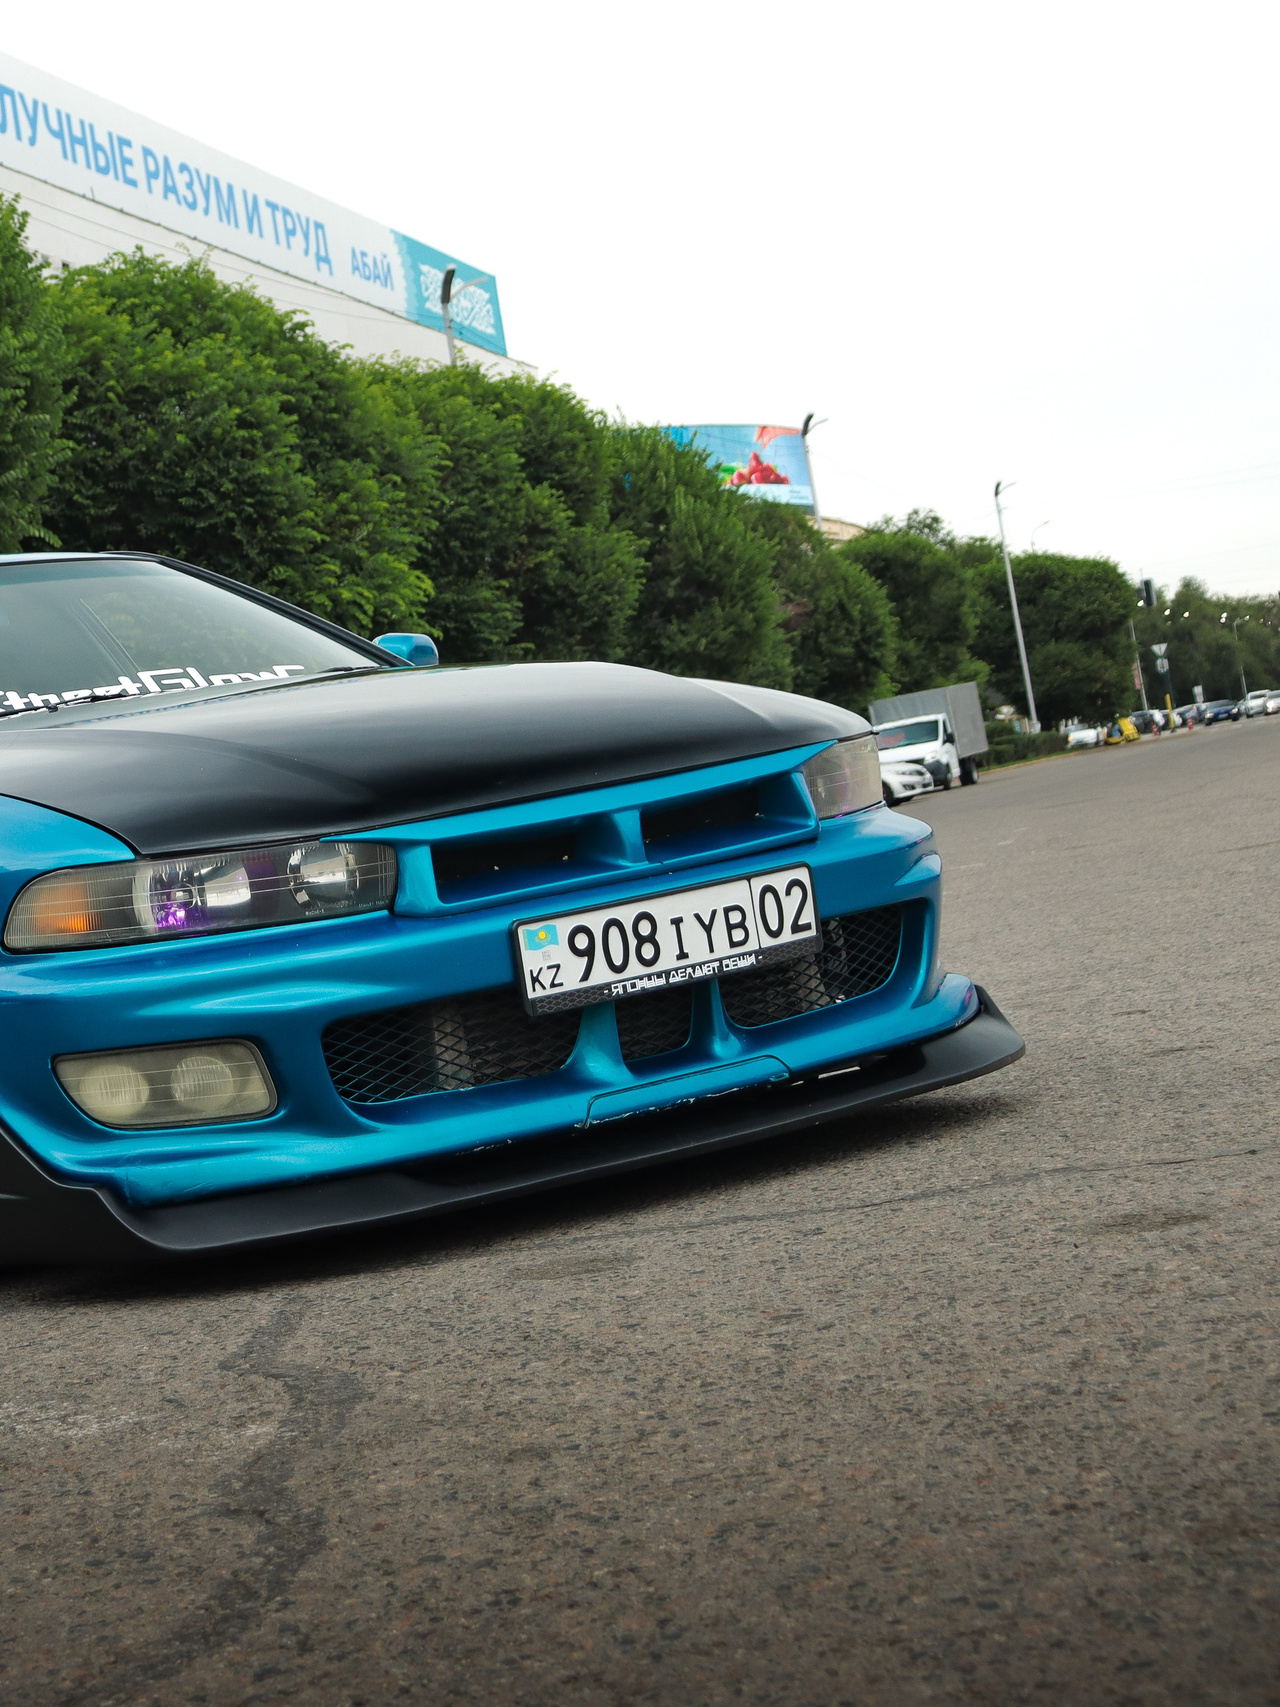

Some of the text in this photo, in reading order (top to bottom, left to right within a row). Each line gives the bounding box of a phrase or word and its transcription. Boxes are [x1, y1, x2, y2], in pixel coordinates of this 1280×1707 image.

[141, 143, 240, 230] РАЗУМ
[242, 188, 264, 240] И
[264, 198, 334, 277] ТРУД
[350, 246, 395, 292] АБАЙ
[528, 963, 564, 993] KZ
[566, 877, 812, 983] 908 IYB 02
